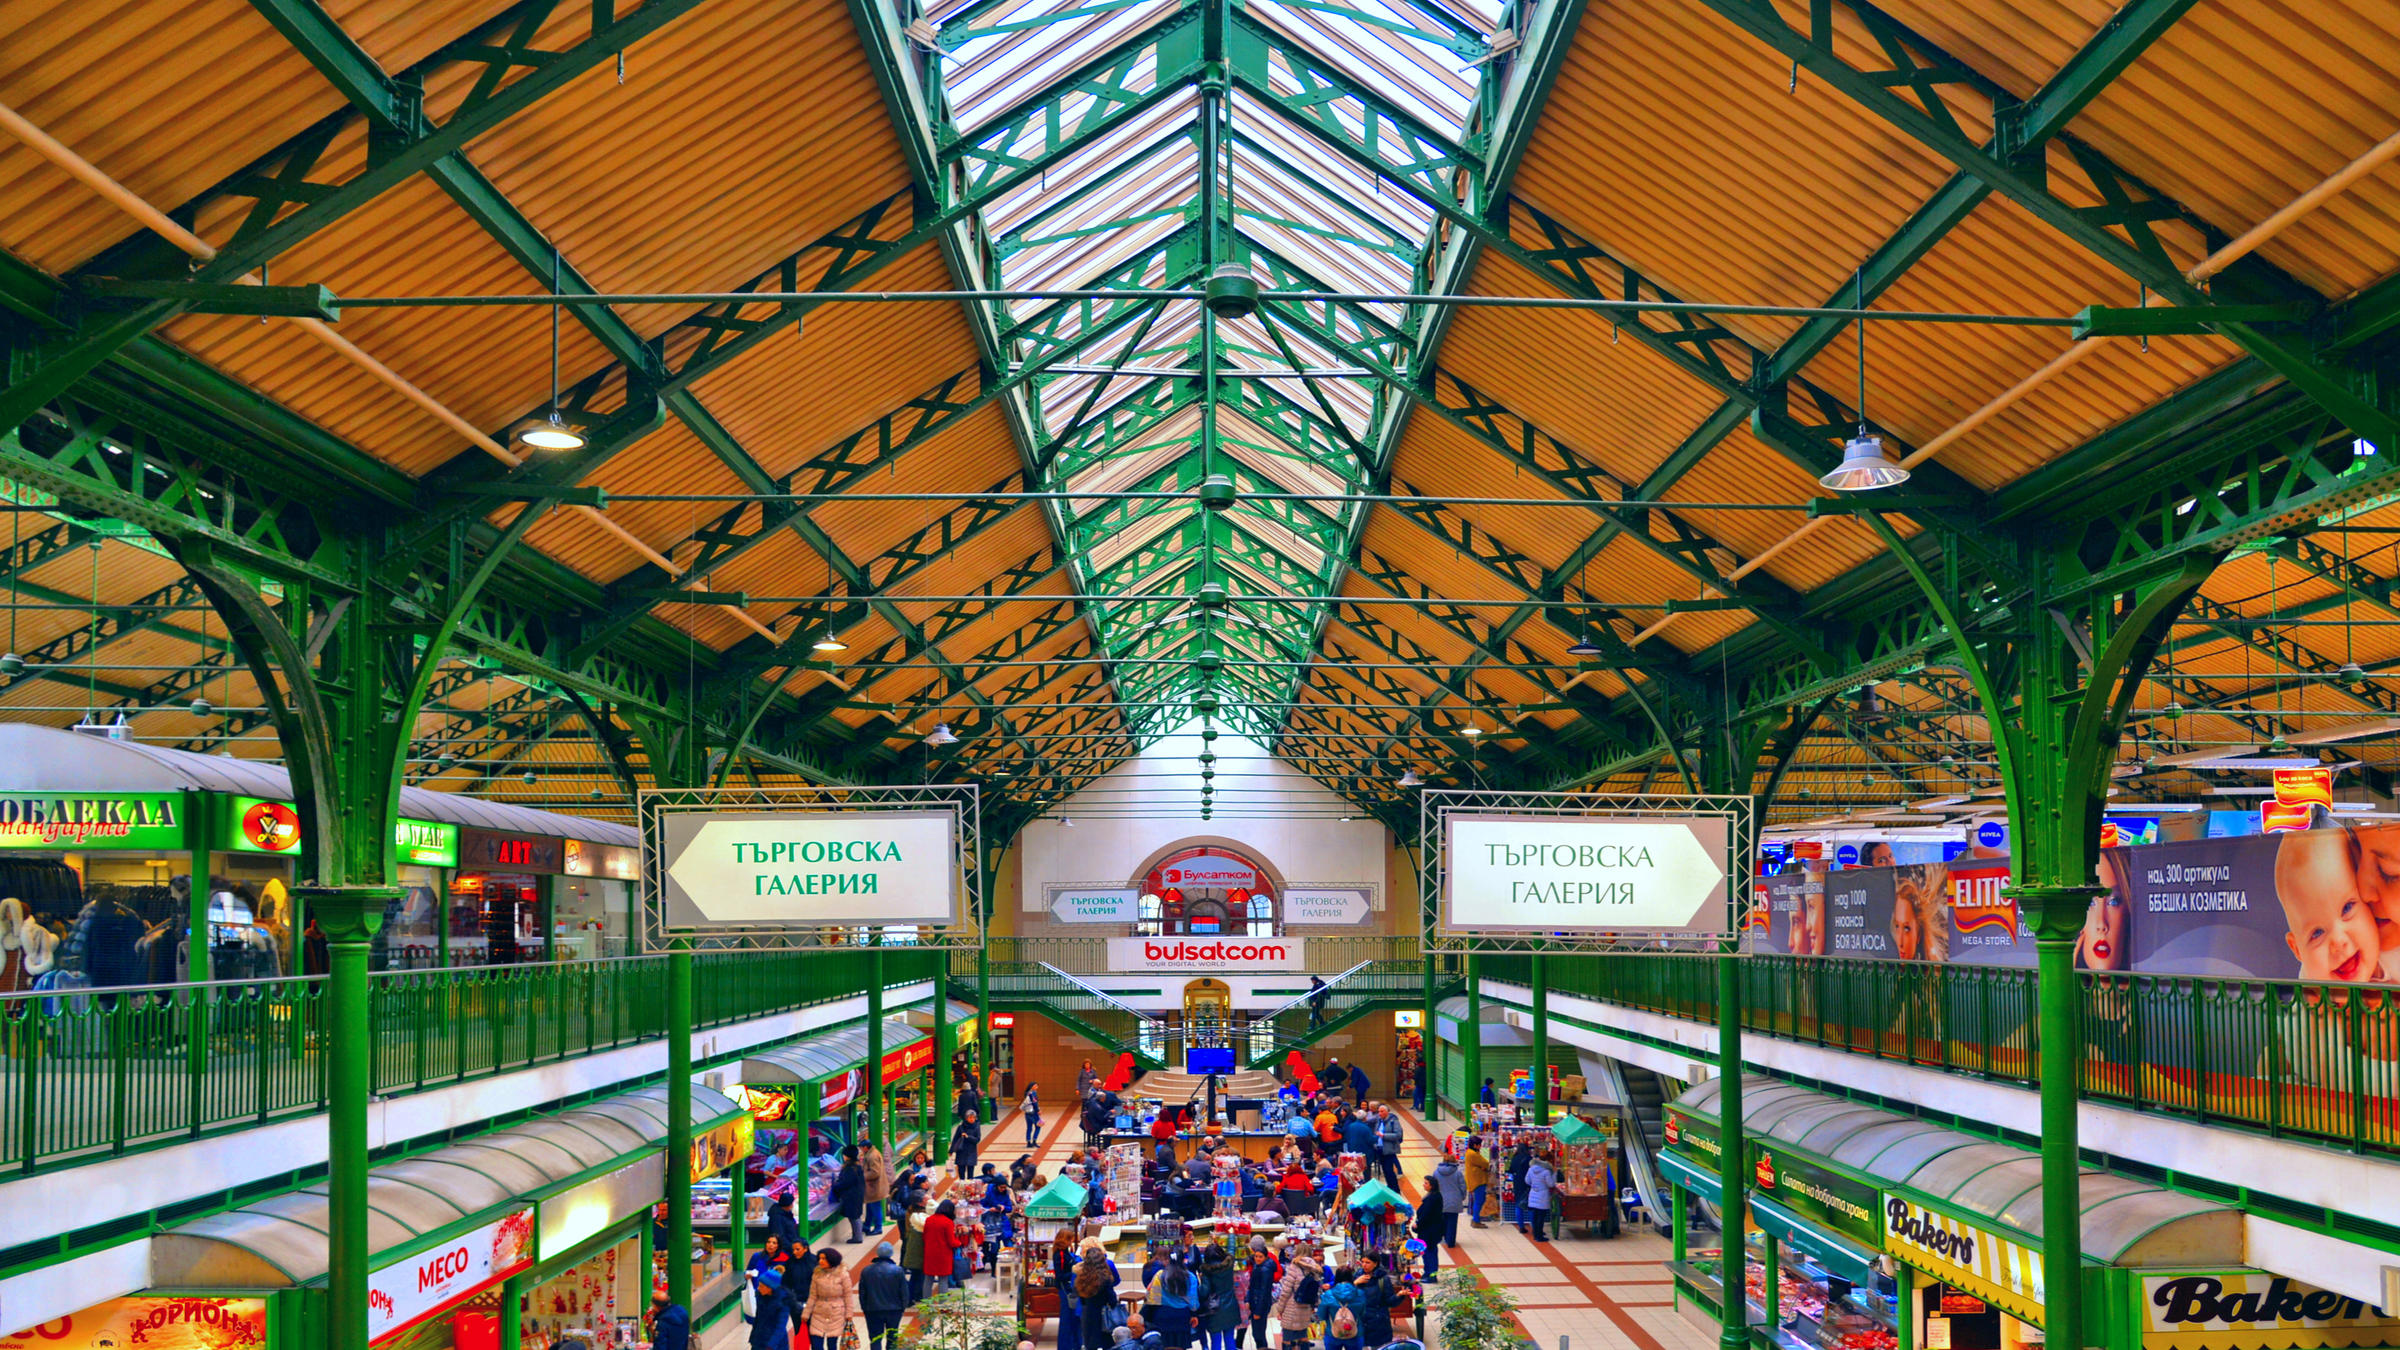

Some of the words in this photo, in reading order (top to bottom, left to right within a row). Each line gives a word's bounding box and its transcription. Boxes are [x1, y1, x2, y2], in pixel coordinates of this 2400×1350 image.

[410, 824, 445, 849] WEAR
[498, 840, 532, 864] ART
[731, 841, 903, 863] ТЪРГОВСКА
[1484, 843, 1655, 868] ТЪРГОВСКА
[755, 873, 878, 896] ГАЛЕРИЯ
[1184, 869, 1252, 883] Булсатком
[2147, 868, 2165, 886] над
[2166, 863, 2182, 883] 300
[2183, 864, 2230, 887] артикула
[1071, 896, 1124, 906] ТЪРГОВСКА
[1295, 896, 1348, 906] ТЪРГОВСКА
[1511, 881, 1634, 905] ГАЛЕРИЯ
[1834, 893, 1849, 910] над
[1850, 889, 1867, 907] 1000
[2189, 891, 2248, 912] КОЗМЕТИКА
[1077, 907, 1117, 916] ГАЛЕРИЯ
[1302, 908, 1342, 918] ГАЛЕРИЯ
[1834, 916, 1864, 928] нюанса
[1144, 941, 1286, 961] bulsatcom
[1835, 935, 1849, 950] БОЯ
[1850, 934, 1862, 950] ЗА
[1862, 934, 1886, 951] КОСА
[1962, 936, 1983, 945] MEGA
[1985, 936, 2011, 945] STORE
[1705, 1137, 1722, 1156] добра
[1781, 1170, 1806, 1194] Силата
[1806, 1186, 1815, 1197] на
[1815, 1184, 1846, 1212] добрата
[1846, 1203, 1869, 1222] храна
[1887, 1198, 1974, 1265] Bakers
[2153, 1276, 2392, 1323] Baker
[150, 1302, 240, 1330] ОРИОН
